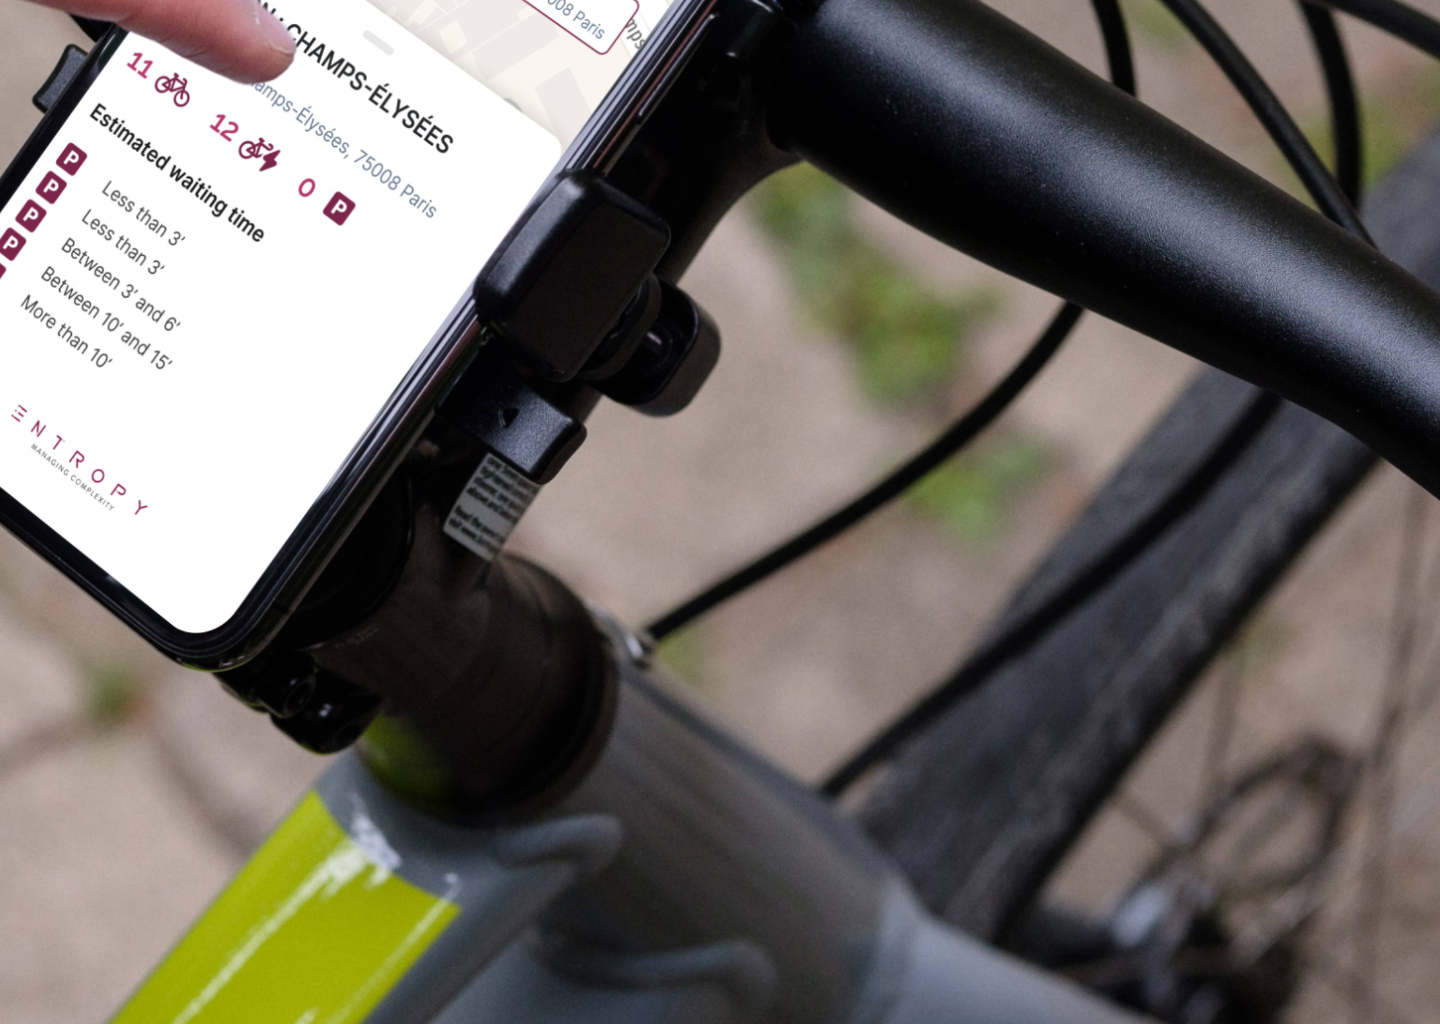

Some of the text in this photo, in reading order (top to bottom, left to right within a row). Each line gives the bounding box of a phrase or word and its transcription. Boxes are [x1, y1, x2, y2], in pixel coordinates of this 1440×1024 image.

[573, 10, 605, 40] Paris
[126, 52, 154, 79] 11
[210, 113, 239, 142] 12
[287, 24, 454, 154] CHAMPS-ÉLYSÉES
[89, 103, 265, 242] Estimated waiting time
[250, 81, 437, 218] amps-Élysées, 75008 Paris
[81, 209, 115, 241] Less
[115, 235, 148, 266] than
[102, 180, 135, 212] Less
[135, 207, 168, 238] than
[20, 294, 57, 329] More
[57, 323, 89, 354] than
[41, 266, 100, 318] Between
[120, 330, 151, 356] and
[61, 238, 120, 290] Between
[135, 298, 166, 323] and
[11, 404, 148, 515] ENTROPY
[30, 443, 115, 511] MANAGING COMPLEXITY
